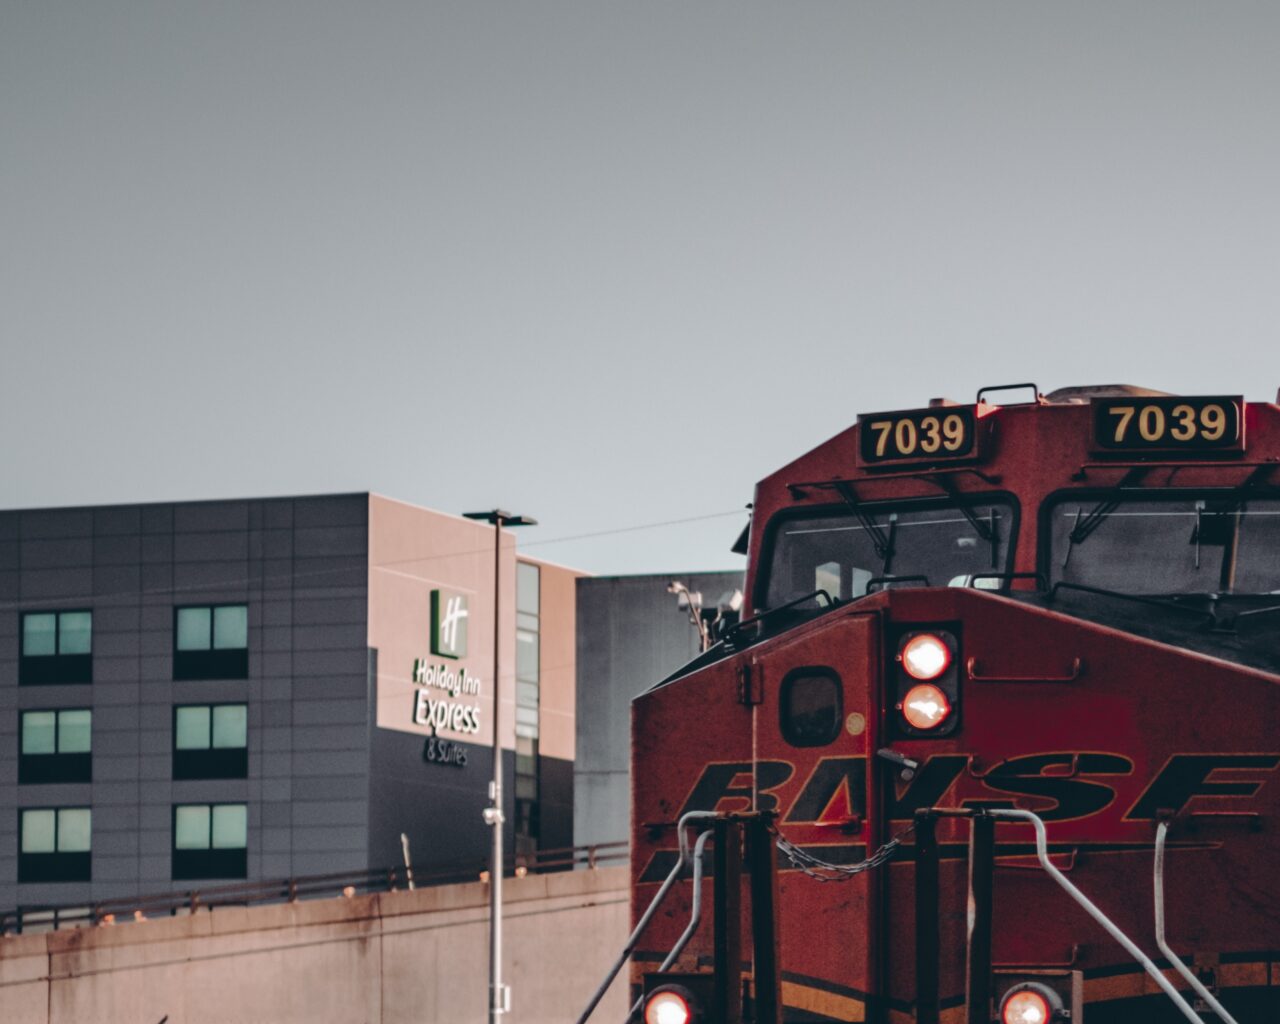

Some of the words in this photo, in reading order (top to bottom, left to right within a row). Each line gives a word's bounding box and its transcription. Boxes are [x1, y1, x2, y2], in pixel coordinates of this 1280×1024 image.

[870, 414, 965, 458] 7039
[1108, 403, 1227, 443] 7039
[415, 658, 463, 698] Holiday
[463, 667, 481, 695] Inn
[414, 689, 480, 735] Express
[426, 738, 436, 762] &
[437, 740, 469, 767] Suites
